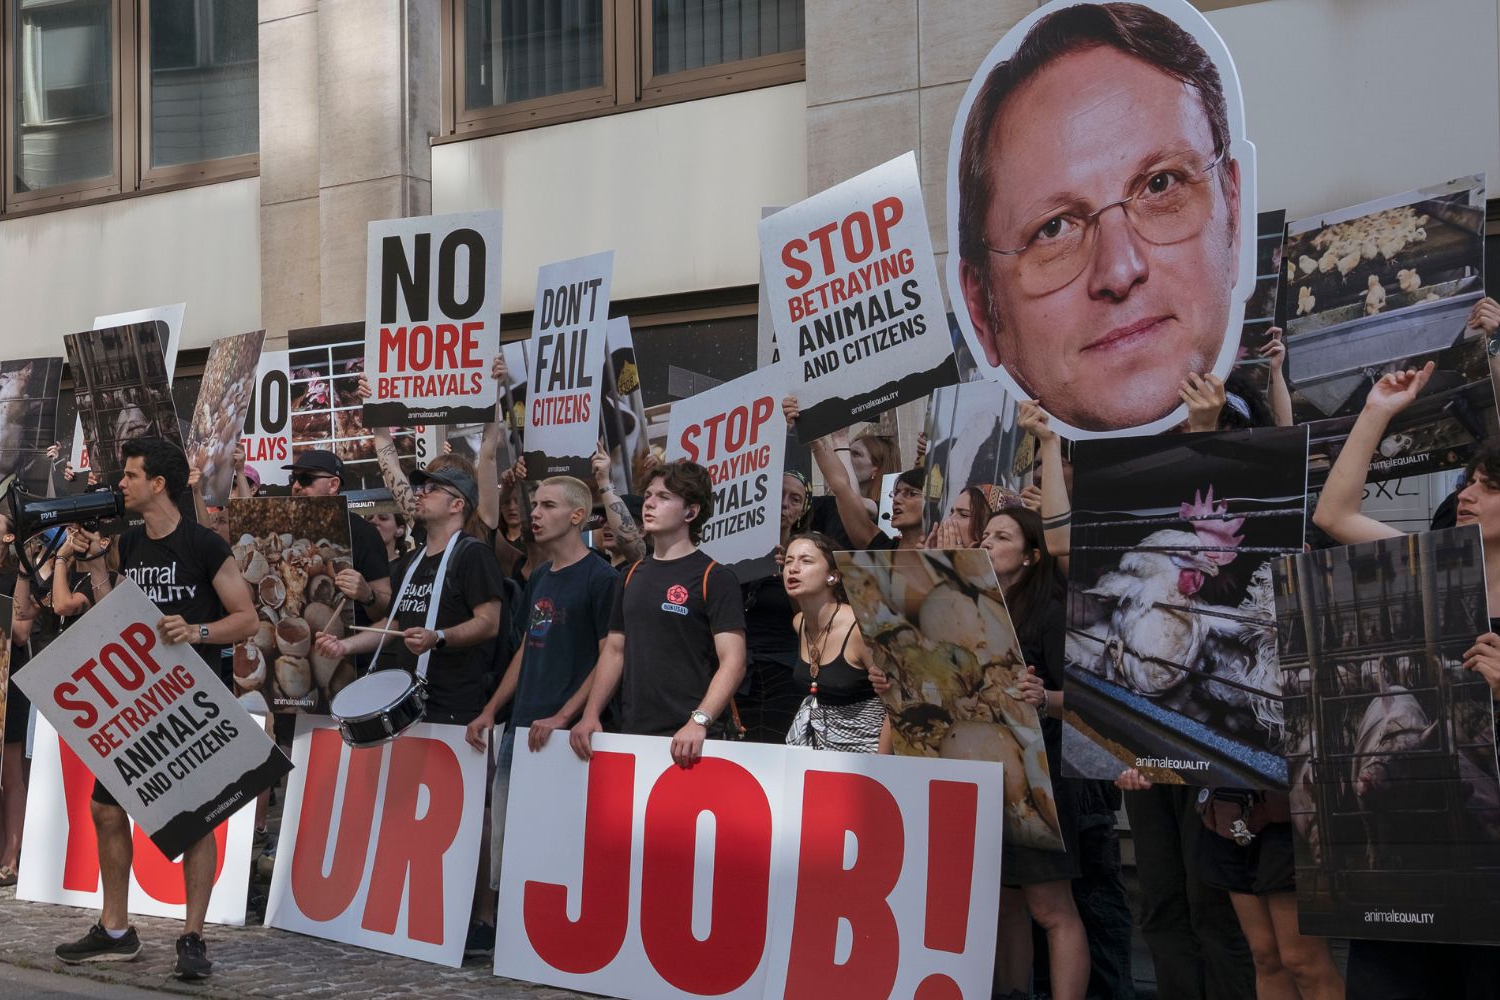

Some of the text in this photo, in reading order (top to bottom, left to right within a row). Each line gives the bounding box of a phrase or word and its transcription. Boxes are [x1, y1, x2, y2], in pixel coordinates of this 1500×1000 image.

[781, 196, 904, 290] STOP
[380, 228, 486, 325] NO
[787, 248, 915, 324] BETRAYING
[540, 278, 602, 331] DON'T
[798, 279, 922, 358] ANIMALS
[378, 321, 485, 373] MORE
[533, 328, 593, 394] FAIL
[804, 313, 927, 383] AND CITIZENS
[377, 371, 483, 400] BETRAYALS
[531, 392, 591, 428] CITIZENS
[851, 390, 899, 415] animalEQUALITY
[407, 411, 448, 419] animalEQUALITY
[677, 395, 775, 466] STOP
[706, 444, 771, 487] RAYING
[40, 511, 58, 521] PYLE
[711, 473, 768, 518] MALS
[700, 505, 766, 544] CITIZENS
[125, 561, 177, 585] animal
[143, 585, 197, 604] ALITY
[53, 622, 162, 729] STOP
[87, 664, 196, 759] BETRAYING
[113, 690, 221, 787] ANIMALS
[135, 718, 240, 808] AND CITIZENS
[1135, 755, 1211, 771] animalEQUALITY
[204, 790, 245, 823] animalEQUALITY
[522, 750, 979, 1000] JOB!
[1364, 908, 1435, 924] animalEQUALITY
